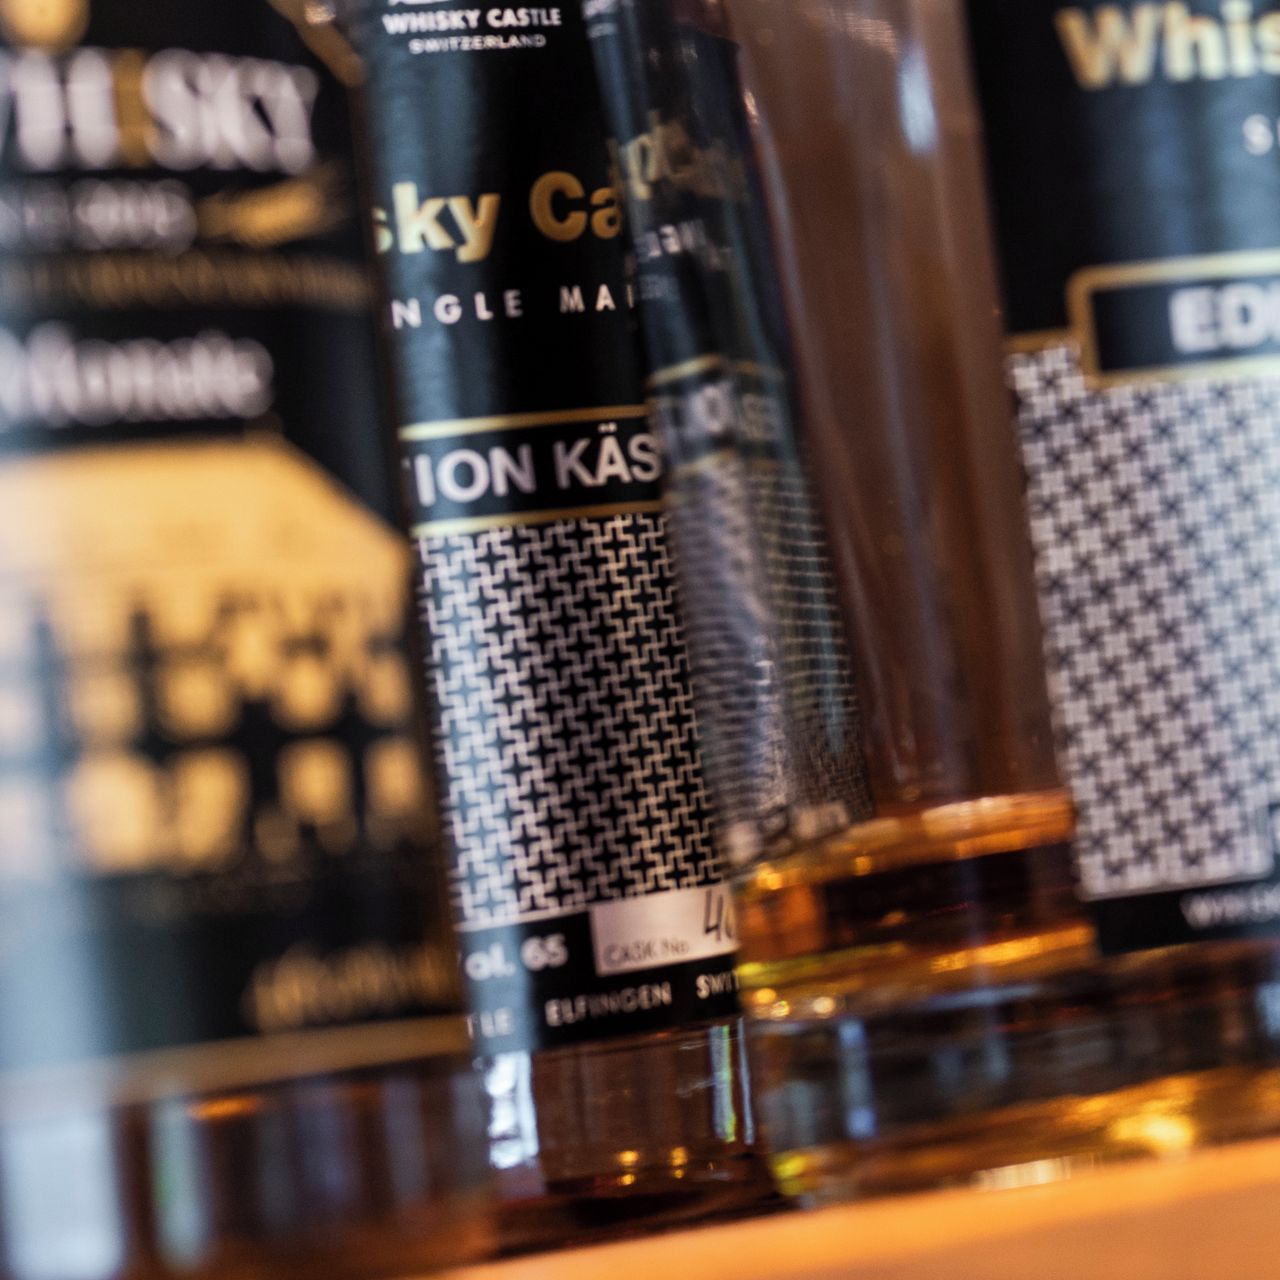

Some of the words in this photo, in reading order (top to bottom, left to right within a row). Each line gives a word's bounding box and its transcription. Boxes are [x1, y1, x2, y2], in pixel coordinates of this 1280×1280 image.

[382, 9, 480, 35] WHISKY
[486, 8, 562, 28] CASTLE
[408, 34, 546, 54] SWITZERLAND
[373, 182, 500, 263] sky
[391, 290, 523, 329] NGLE
[402, 442, 537, 507] ION
[465, 942, 516, 982] ol.
[545, 981, 672, 1027] ELFINGEN
